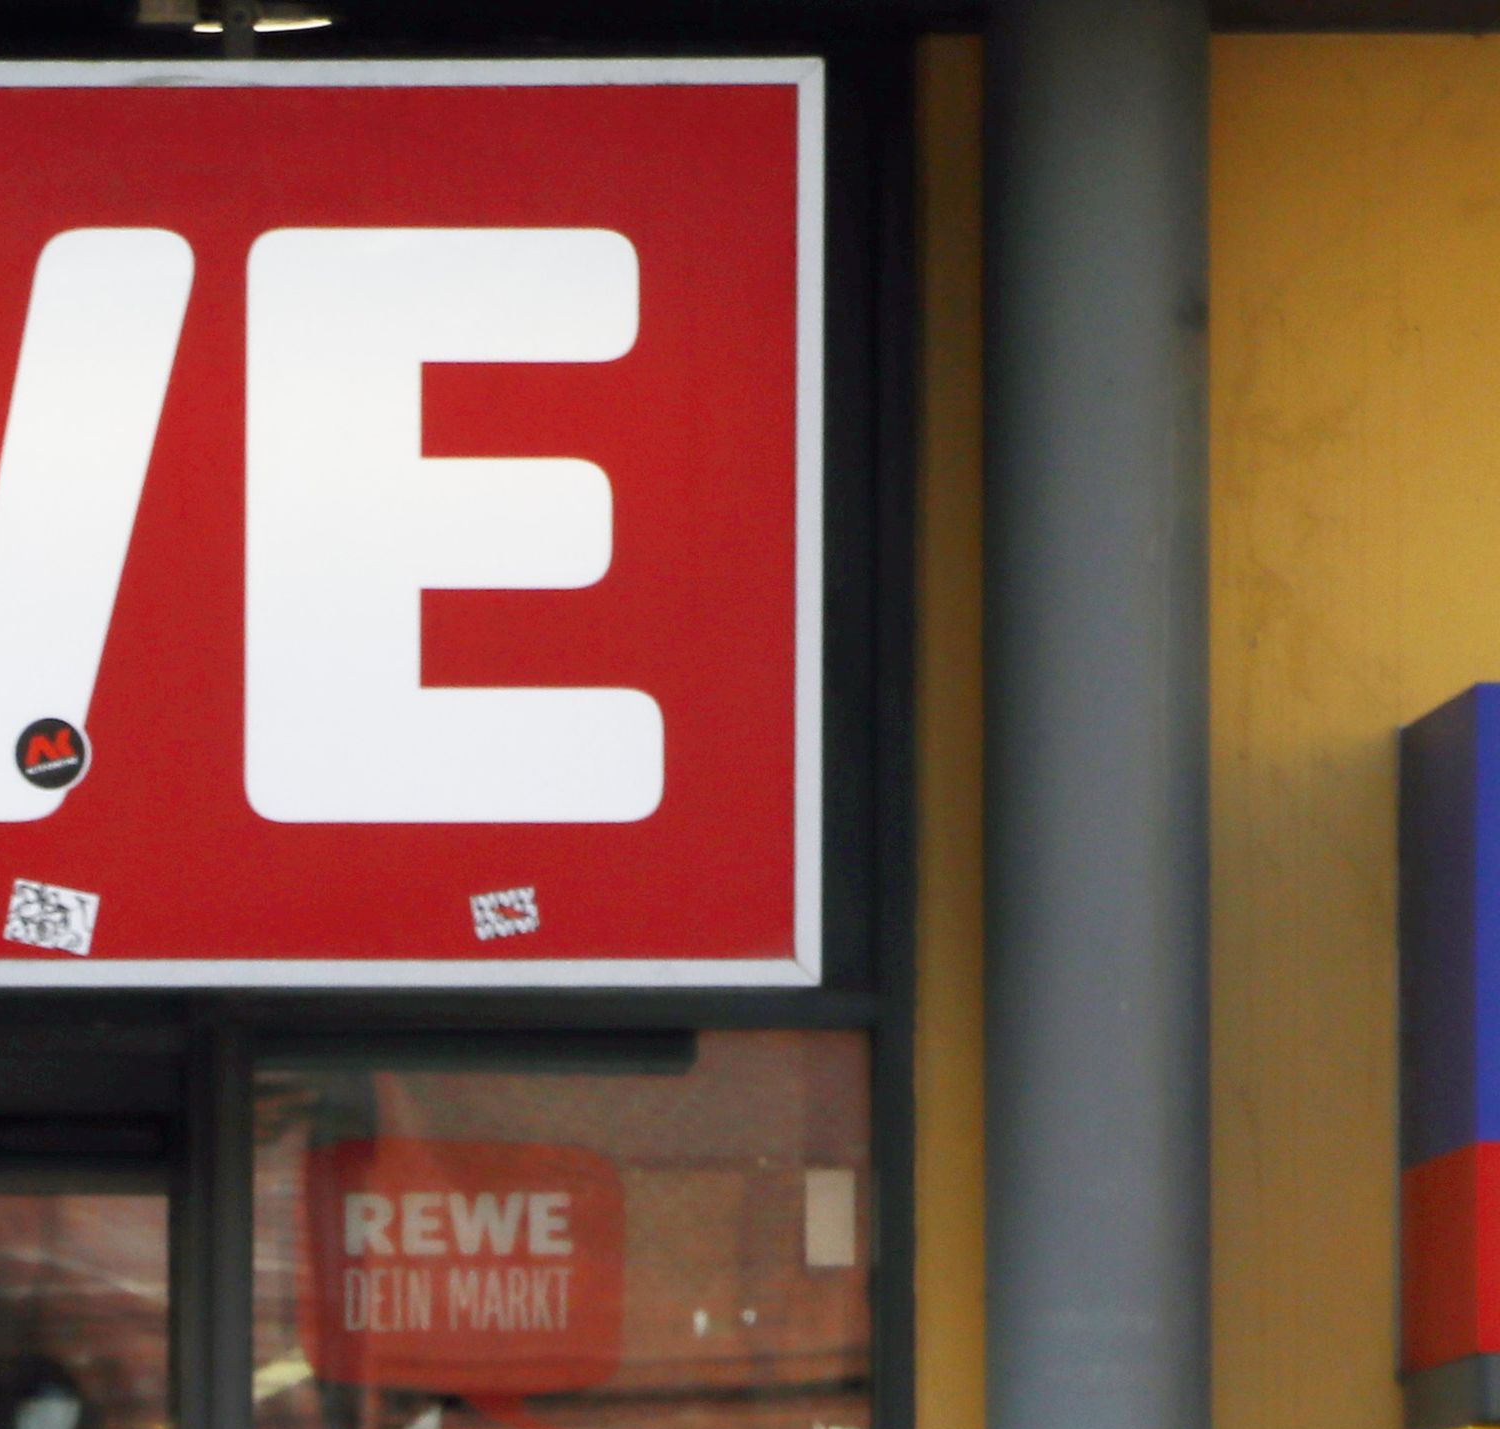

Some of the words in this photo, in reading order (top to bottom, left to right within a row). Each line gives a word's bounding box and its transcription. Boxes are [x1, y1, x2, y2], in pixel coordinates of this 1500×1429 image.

[344, 1193, 572, 1256] REWE
[344, 1267, 432, 1332] DEIN
[448, 1266, 574, 1332] MARKT
